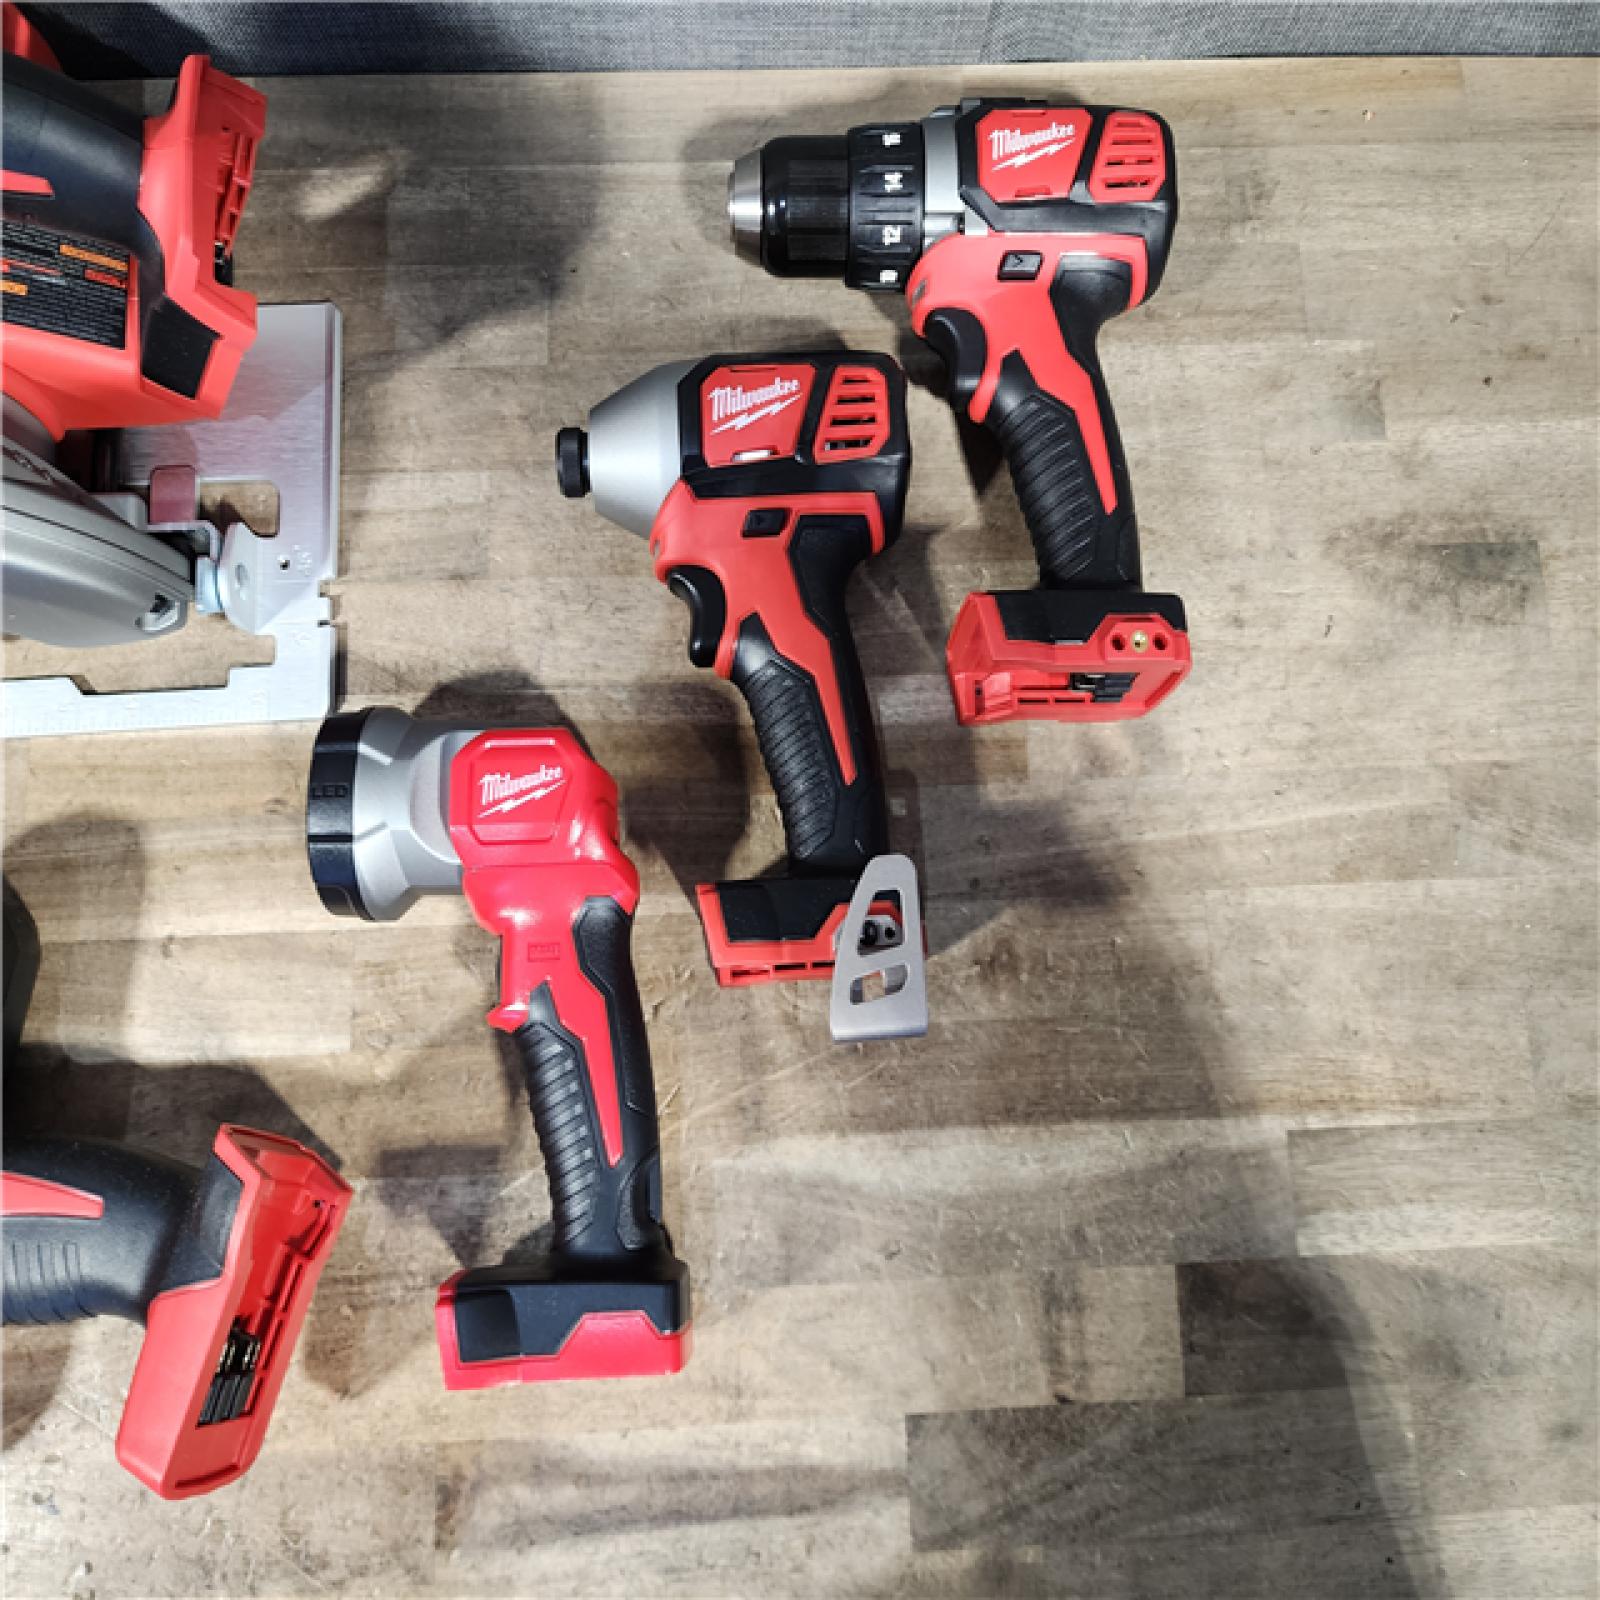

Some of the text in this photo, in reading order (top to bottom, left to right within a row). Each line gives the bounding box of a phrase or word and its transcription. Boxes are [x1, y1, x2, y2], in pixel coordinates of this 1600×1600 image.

[988, 121, 1075, 160] Milwaukee
[882, 225, 901, 246] 12
[707, 376, 799, 421] Milwaukee
[312, 784, 348, 800] LED
[478, 764, 563, 805] Milwaukee
